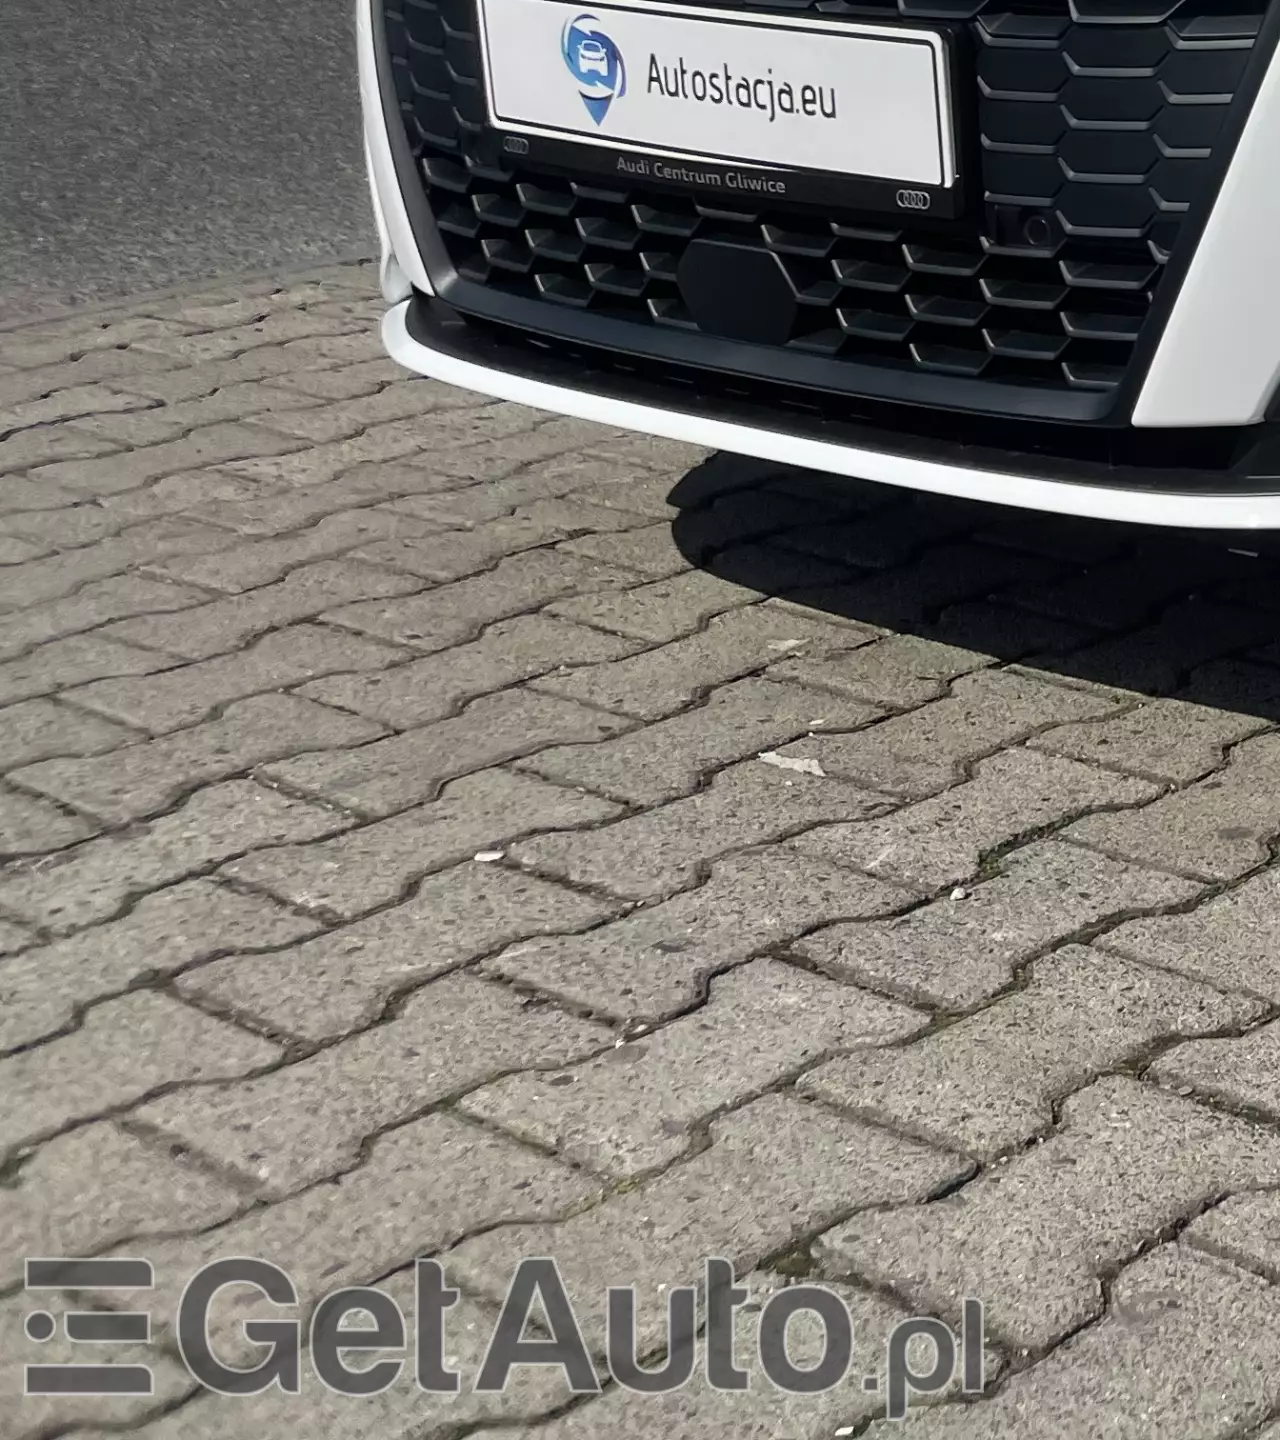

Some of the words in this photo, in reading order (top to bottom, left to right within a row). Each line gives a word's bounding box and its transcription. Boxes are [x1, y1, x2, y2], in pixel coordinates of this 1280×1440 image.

[646, 52, 837, 122] Autostacja.eu
[617, 156, 650, 175] Audi
[654, 162, 721, 186] Centrum
[725, 171, 786, 194] Gliwice
